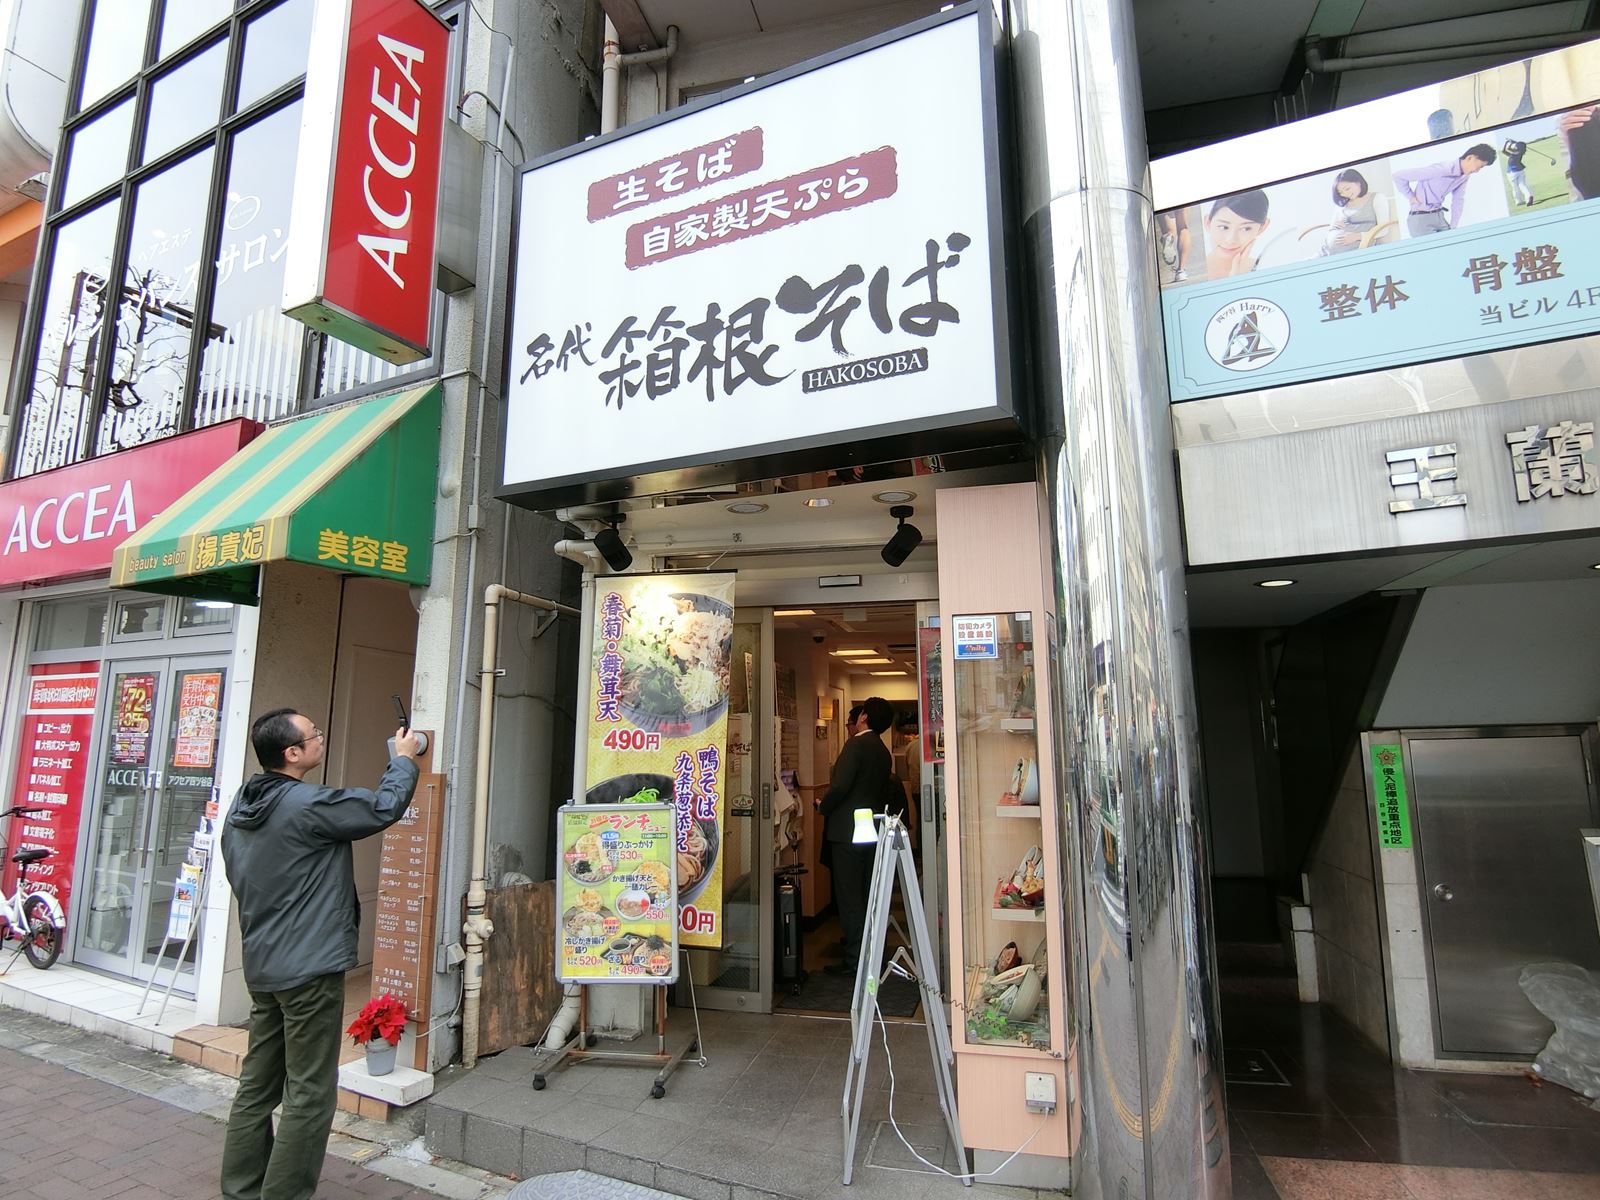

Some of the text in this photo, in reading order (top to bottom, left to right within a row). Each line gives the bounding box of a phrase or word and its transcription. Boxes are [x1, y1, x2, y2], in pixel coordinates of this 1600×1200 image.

[357, 34, 426, 290] ACCEA
[612, 138, 738, 211] 生そば
[641, 168, 871, 259] 自家製天ぷら
[1462, 243, 1566, 295] 骨盤
[519, 232, 972, 412] 名代 箱根そば
[1240, 301, 1276, 314] Harry
[1317, 273, 1411, 323] 整体
[1479, 296, 1559, 326] 当ビル
[806, 352, 925, 392] HAKOSOBA
[3, 478, 138, 557] ACCEA
[129, 550, 187, 574] beauty salon
[318, 528, 409, 574] 美容室
[597, 592, 624, 722] 春菊・舞茸天
[603, 730, 661, 751] 490円
[697, 746, 719, 818] 鴨そば
[1382, 767, 1403, 845] 侵入泥棒追放重点地区
[609, 813, 651, 830] ランチ
[620, 850, 644, 860] 530円
[579, 956, 603, 966] 520円
[621, 965, 647, 975] 490円
